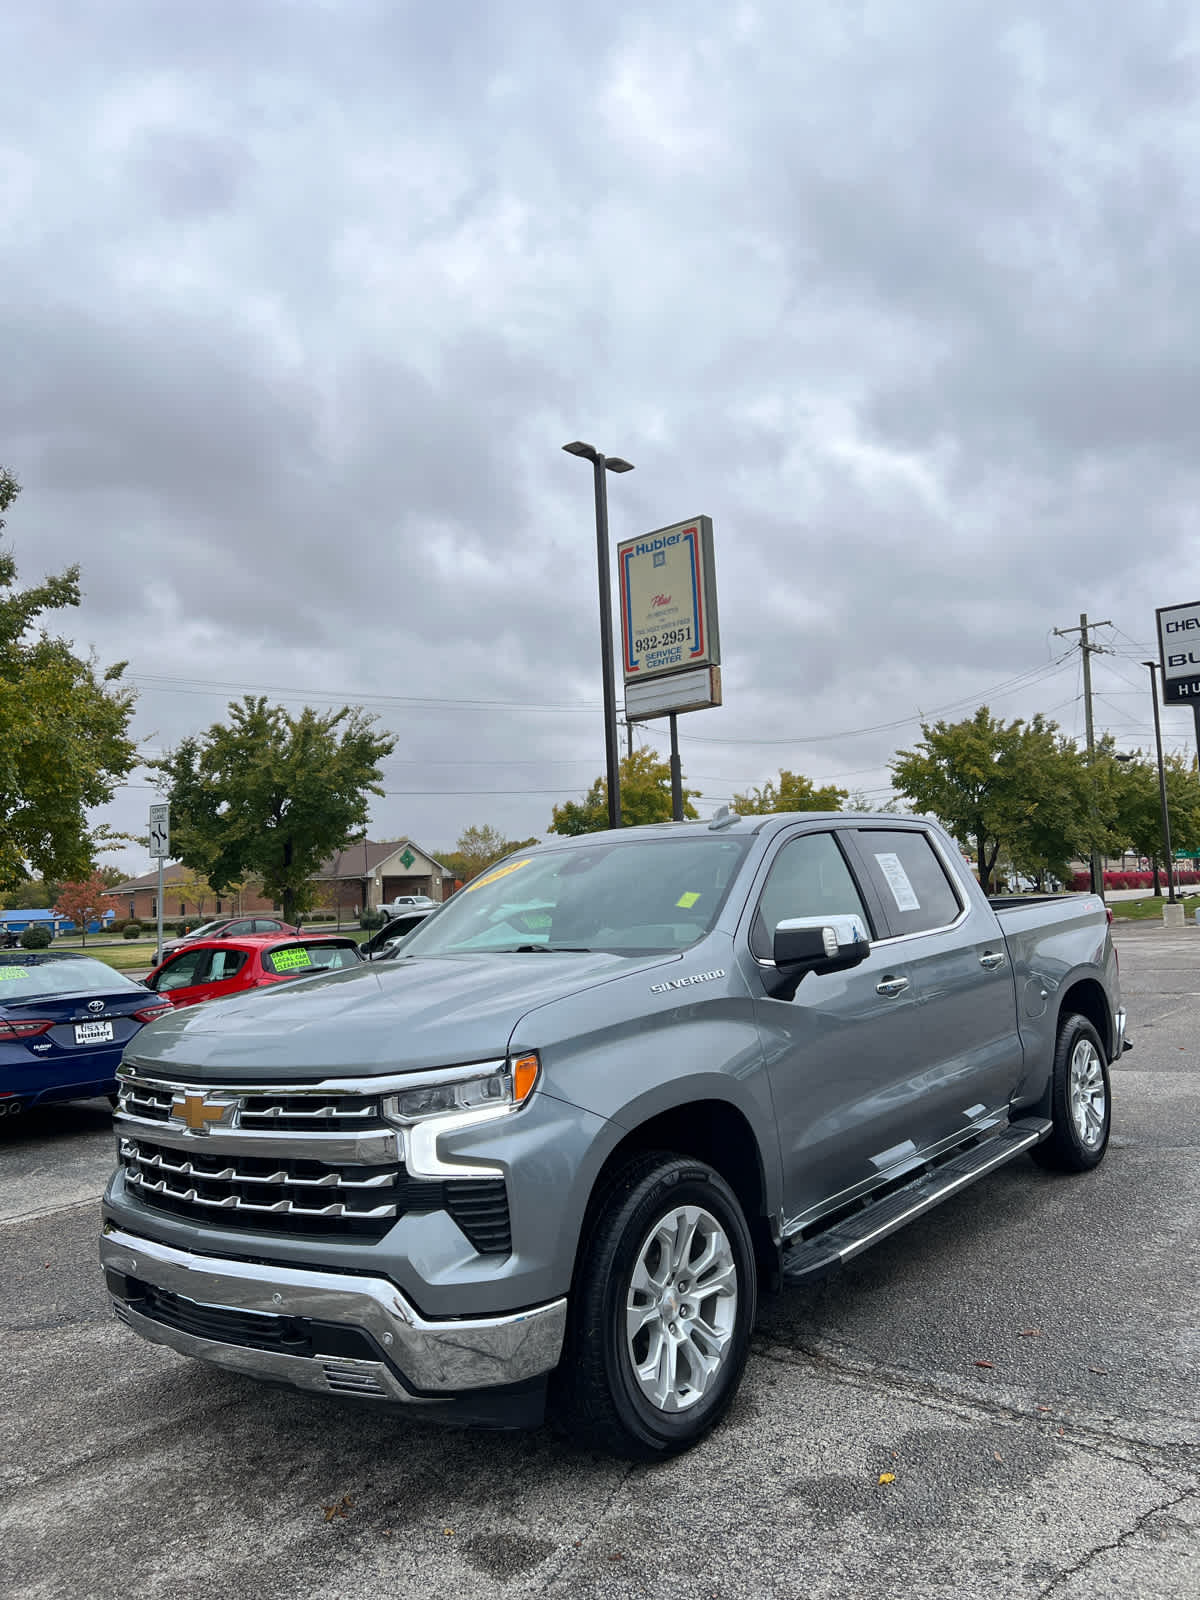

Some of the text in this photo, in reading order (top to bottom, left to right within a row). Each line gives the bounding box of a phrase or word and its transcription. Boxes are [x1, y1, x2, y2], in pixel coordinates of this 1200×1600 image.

[636, 533, 681, 556] Hubler
[635, 626, 691, 653] 932-2951
[645, 646, 682, 661] SERVICE
[647, 654, 682, 669] CENTER
[1178, 682, 1200, 695] HU
[650, 968, 726, 994] SILVERADO
[77, 1030, 111, 1040] Hubler
